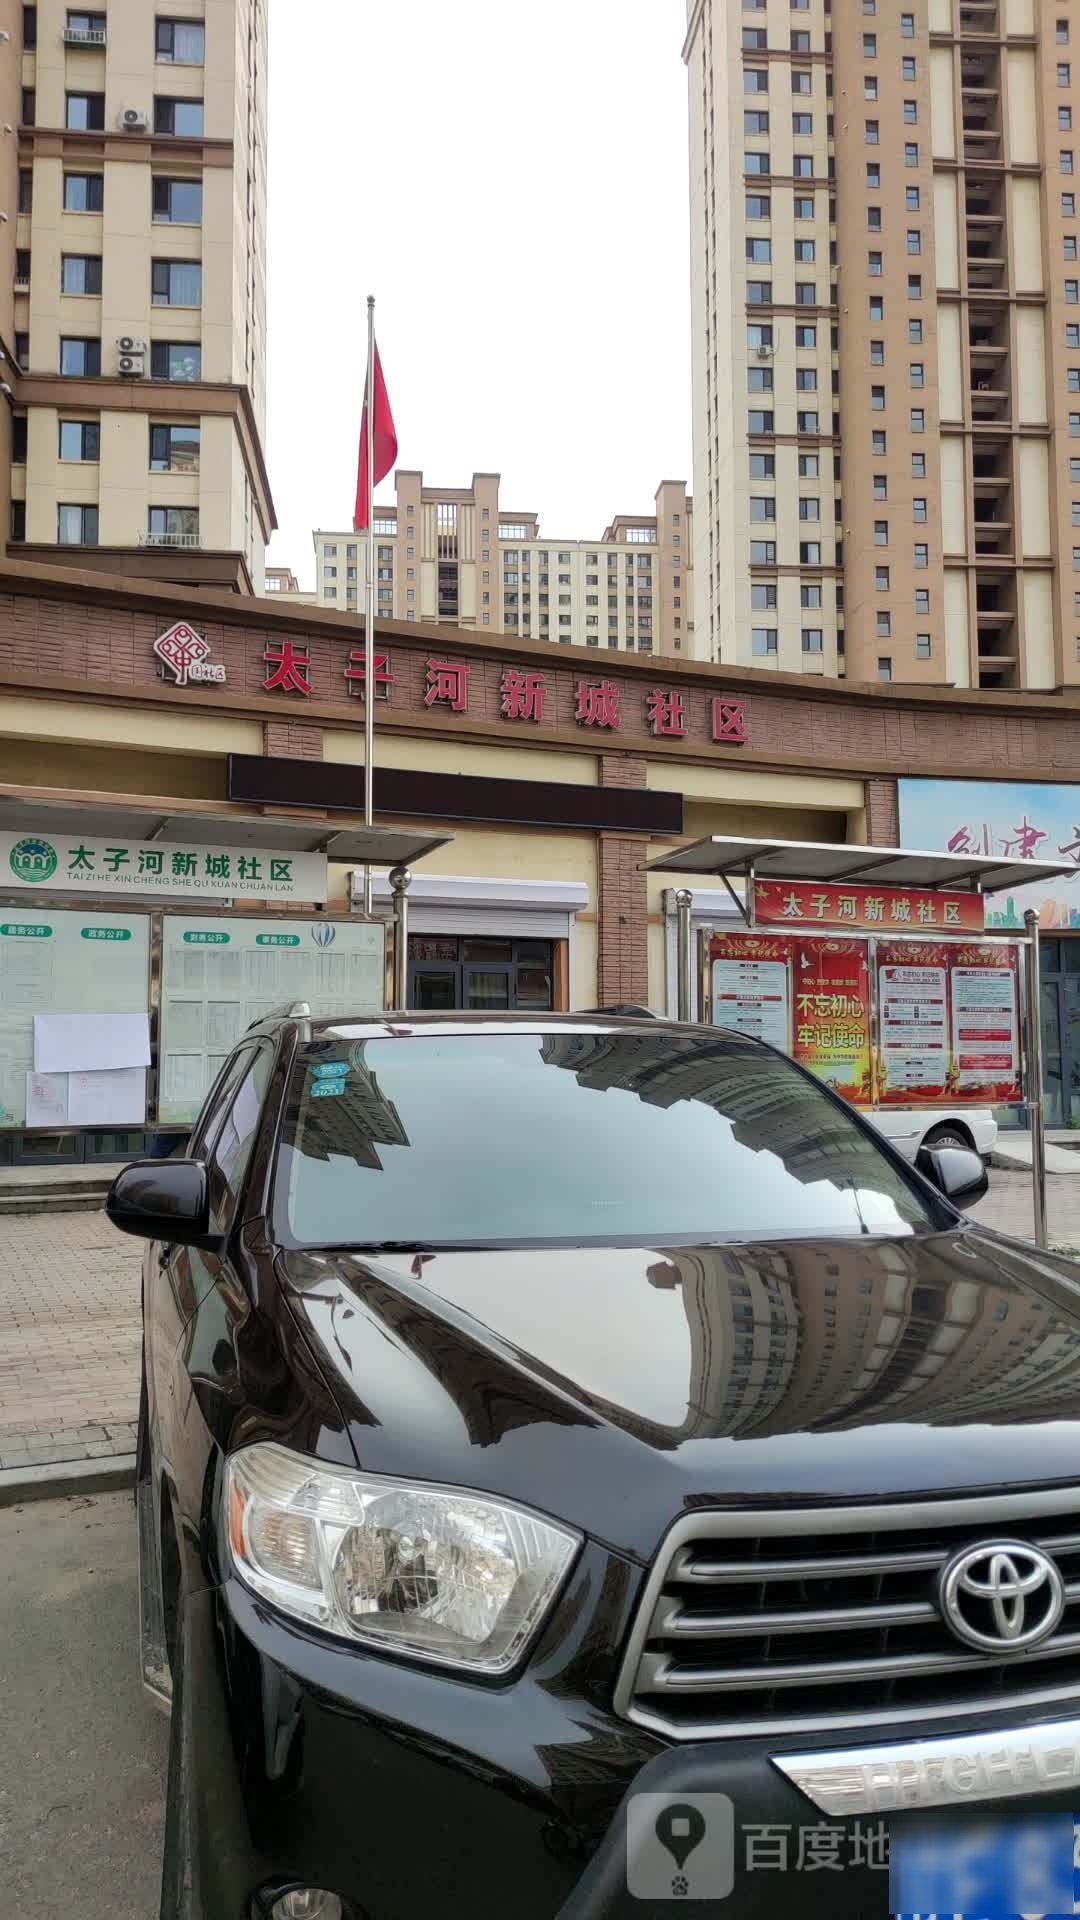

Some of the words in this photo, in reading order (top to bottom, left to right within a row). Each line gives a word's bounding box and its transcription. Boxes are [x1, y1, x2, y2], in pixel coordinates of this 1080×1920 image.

[262, 640, 748, 743] 太子河新城社区
[67, 845, 293, 881] 太子河新城社区
[67, 872, 83, 881] TAI
[97, 874, 111, 882] HE
[114, 875, 131, 883] XIN
[133, 876, 170, 886] CHENG
[172, 878, 191, 887] SHE
[193, 879, 208, 888] QU
[210, 880, 238, 890] XUAN
[275, 883, 293, 892] LAN
[783, 892, 961, 924] 太子河新城社区
[796, 993, 864, 1018] 不忘初心
[797, 1023, 865, 1049] 牢记使命
